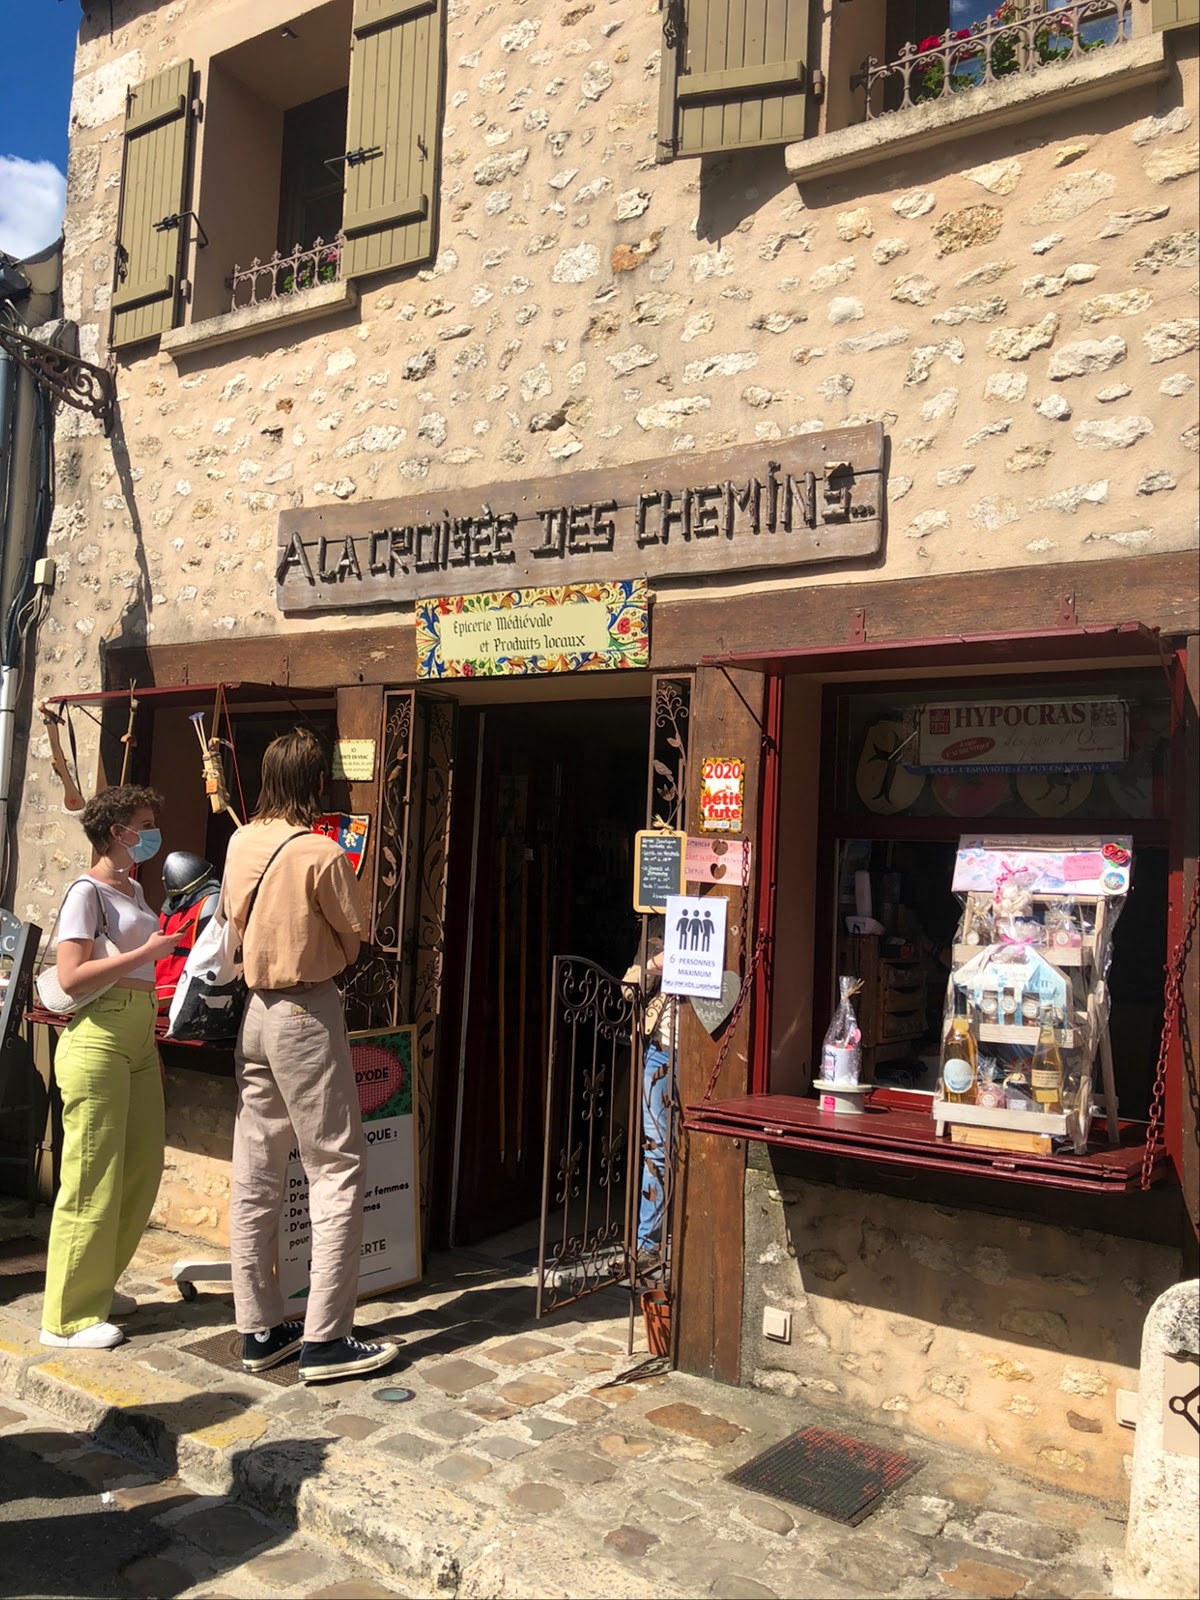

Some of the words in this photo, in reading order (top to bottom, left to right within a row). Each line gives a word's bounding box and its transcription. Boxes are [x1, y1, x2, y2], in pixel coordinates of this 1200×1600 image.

[275, 531, 315, 586] A
[317, 534, 362, 583] LA
[530, 499, 617, 558] DES
[496, 612, 554, 632] Médiévale
[479, 639, 490, 653] et
[494, 636, 541, 652] Produits
[545, 633, 586, 650] locaux
[954, 702, 1086, 729] HYPOCRAS
[705, 762, 741, 779] 2020
[702, 792, 741, 808] petit
[669, 953, 676, 964] 6
[679, 957, 716, 967] PERSONNES
[678, 968, 712, 977] MAXIMUM
[355, 1067, 389, 1083] D'ODE
[364, 1127, 392, 1144] QUE
[289, 1178, 302, 1188] De
[374, 1182, 409, 1196] femmes
[290, 1207, 303, 1217] De
[289, 1235, 310, 1250] pour
